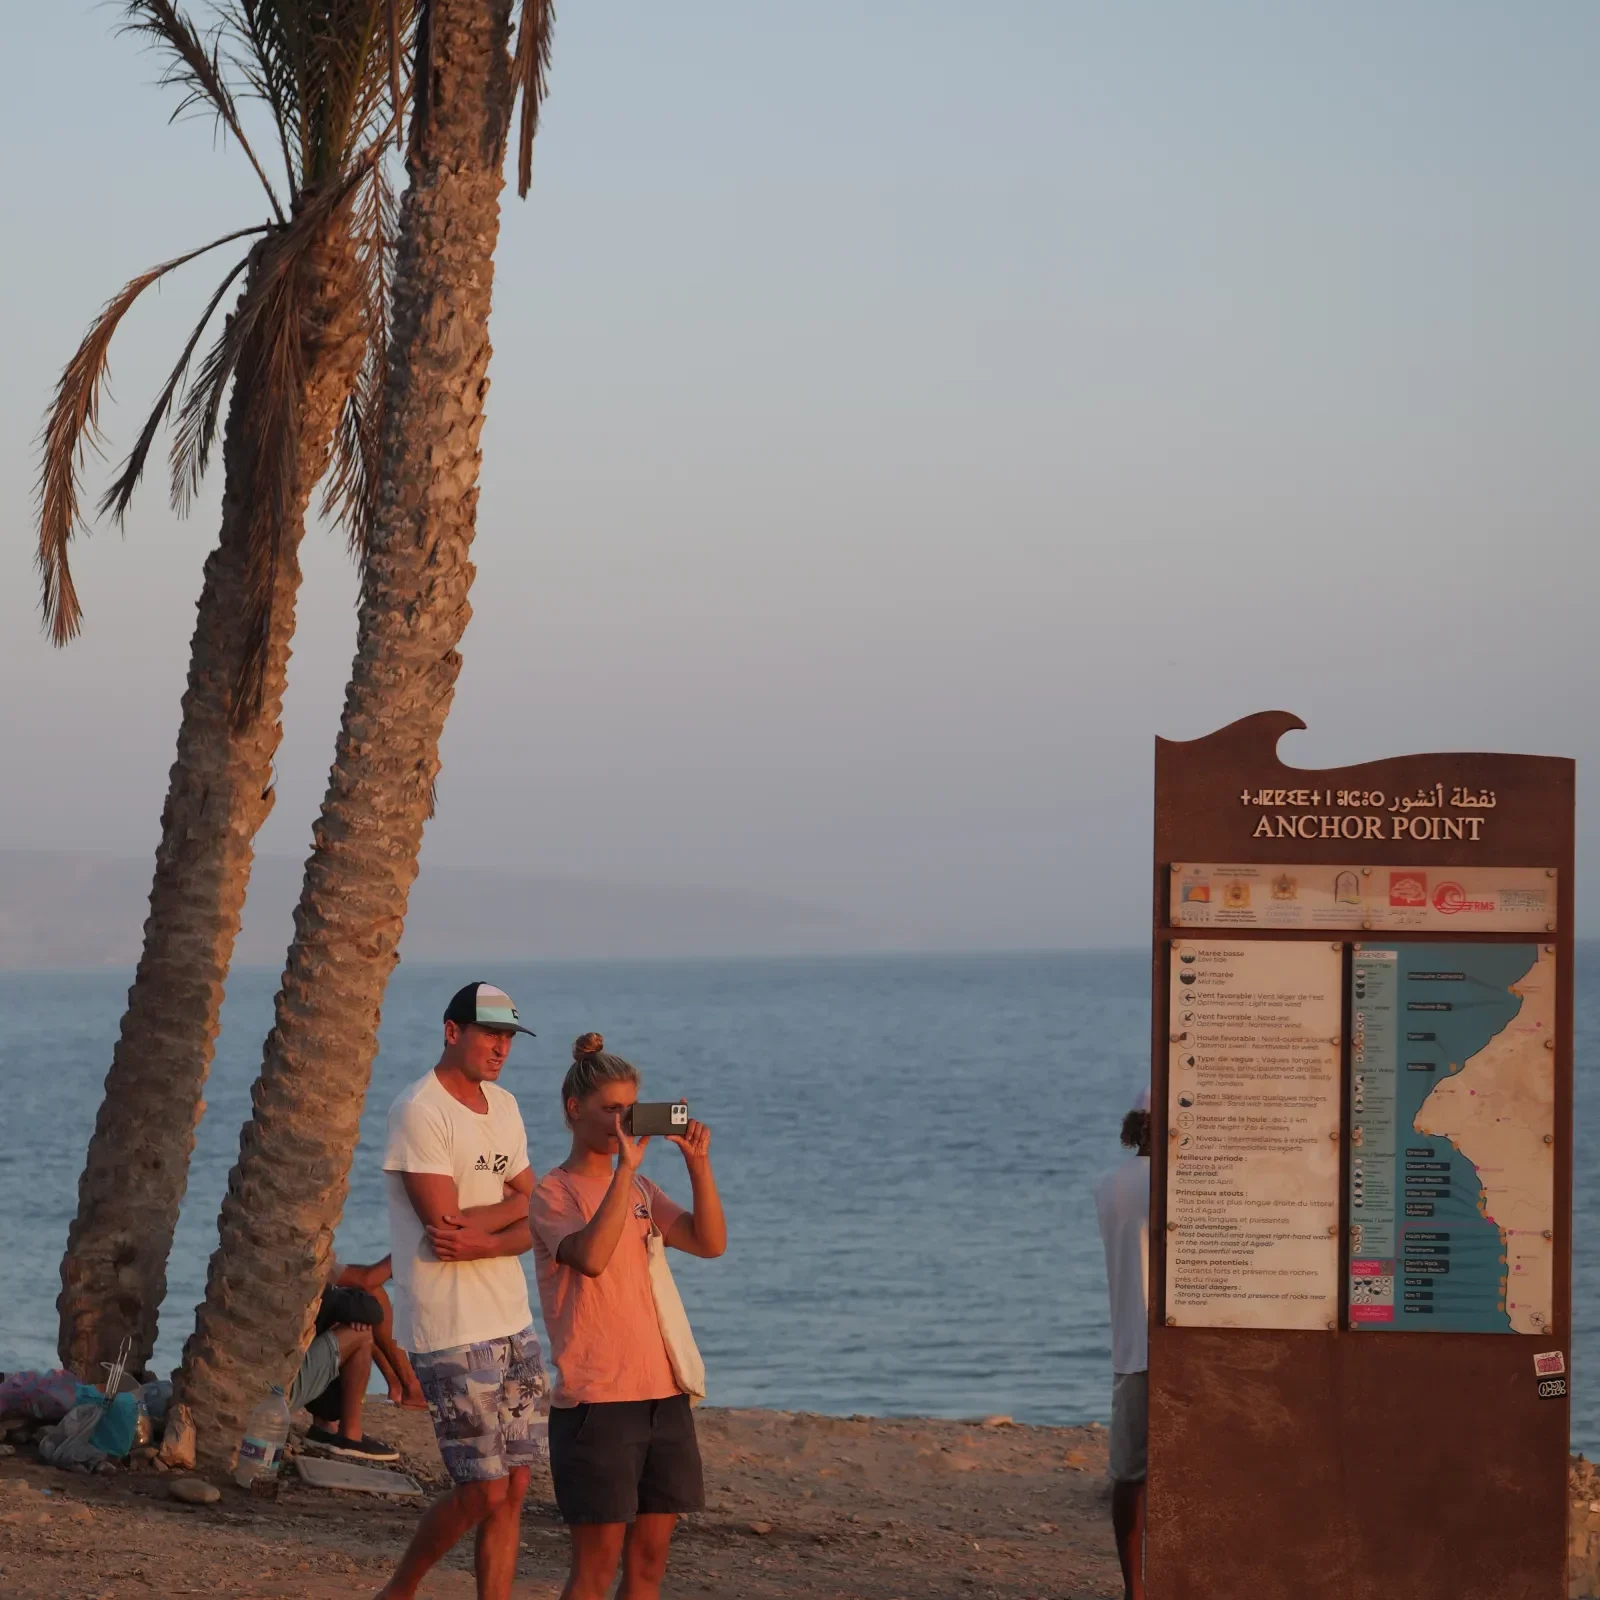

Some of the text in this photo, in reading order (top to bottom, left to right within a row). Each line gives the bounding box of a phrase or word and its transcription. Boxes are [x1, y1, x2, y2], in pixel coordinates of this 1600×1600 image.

[1388, 783, 1496, 813] نقطة أنشور
[1252, 815, 1485, 841] ANCHOR POINT
[1237, 1064, 1294, 1072] principalement
[1277, 1146, 1302, 1154] experts
[1310, 1200, 1334, 1208] littoral
[1208, 1216, 1238, 1224] longues
[1175, 1276, 1191, 1284] près
